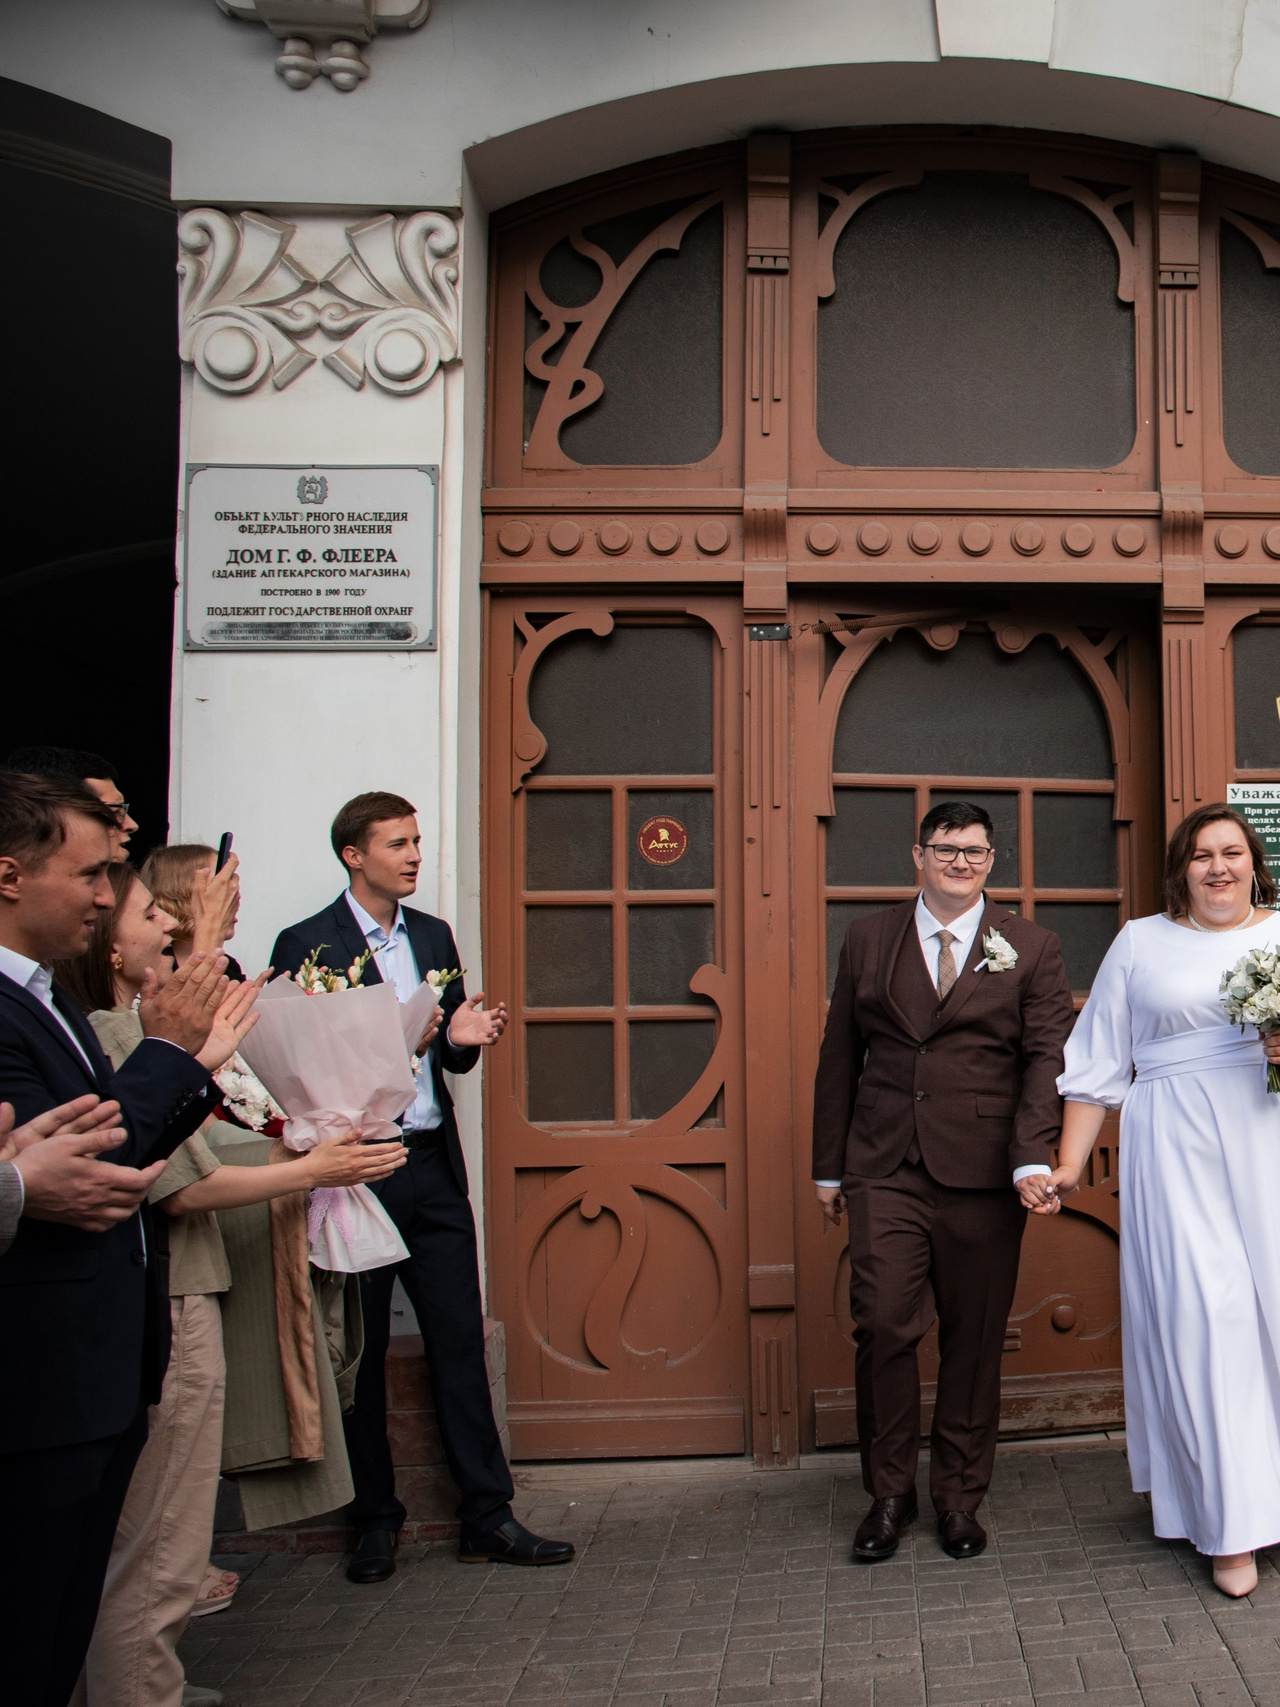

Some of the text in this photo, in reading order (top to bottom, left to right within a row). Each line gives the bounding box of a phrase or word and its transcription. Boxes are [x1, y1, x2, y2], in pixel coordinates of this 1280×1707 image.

[214, 511, 409, 522] ОБЪЕКТ КУЛЬТРНОГО НАСЛЕДИЯ
[238, 524, 393, 535] ФЕДЕРАЛЬНОГО ЗНАЧЕНИЯ
[226, 548, 398, 566] ДОМ Г. Ф. ФЛЕЕРА
[212, 569, 257, 579] (ЗДАНИЕ
[349, 568, 411, 578] МАГАЗИНА)
[260, 588, 313, 596] ПОСТРОЕНО
[344, 588, 367, 597] ГОДУ
[206, 606, 266, 617] ПОДЛЕЖИТ
[268, 605, 372, 617] ГОСУДАРСТВЕННОЙ
[1244, 807, 1262, 816] При
